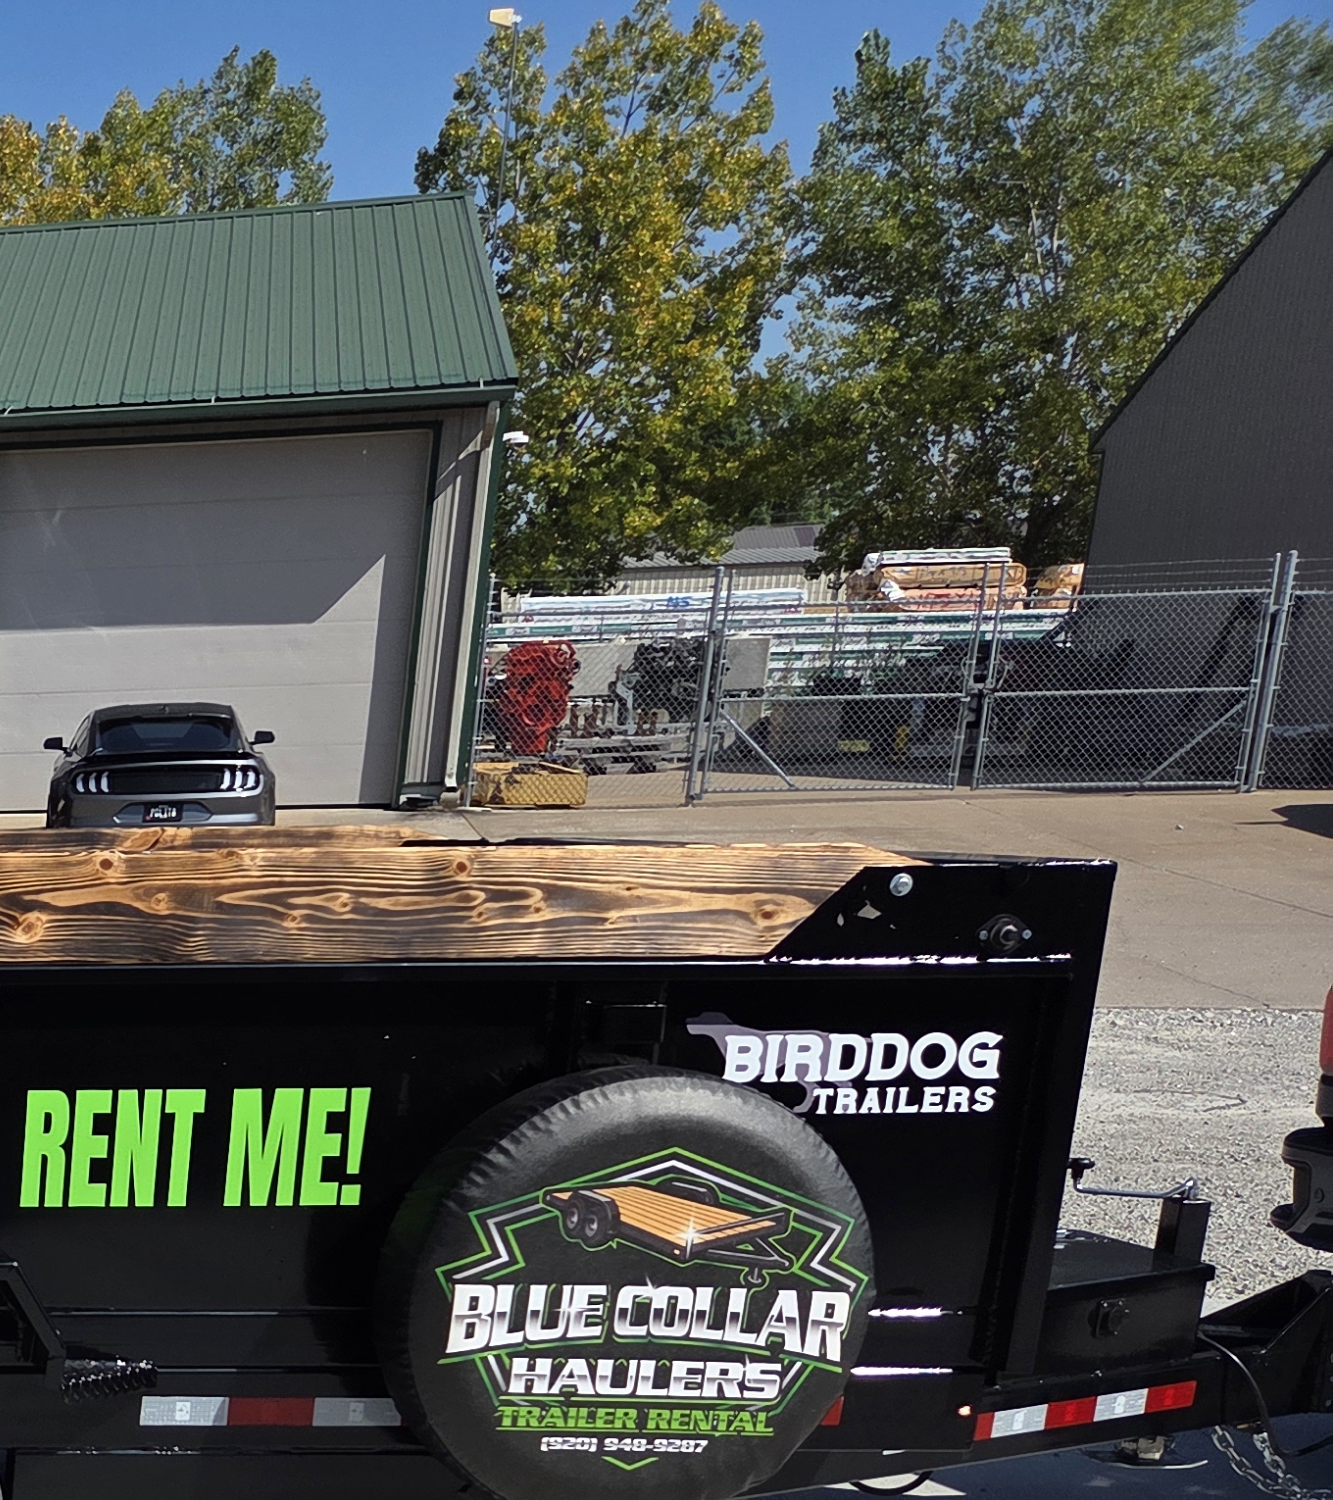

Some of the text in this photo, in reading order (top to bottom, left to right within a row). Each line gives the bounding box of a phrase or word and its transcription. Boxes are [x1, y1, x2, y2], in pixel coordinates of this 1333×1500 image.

[722, 1031, 1004, 1083] BIRDDOG
[813, 1086, 997, 1115] TRAILERS
[19, 1087, 372, 1208] RENT ME!
[445, 1283, 852, 1362] BLUE COLLAR
[507, 1356, 782, 1400] HAULERS
[496, 1406, 773, 1433] TRAILER RENTAL
[540, 1436, 598, 1452] (920)
